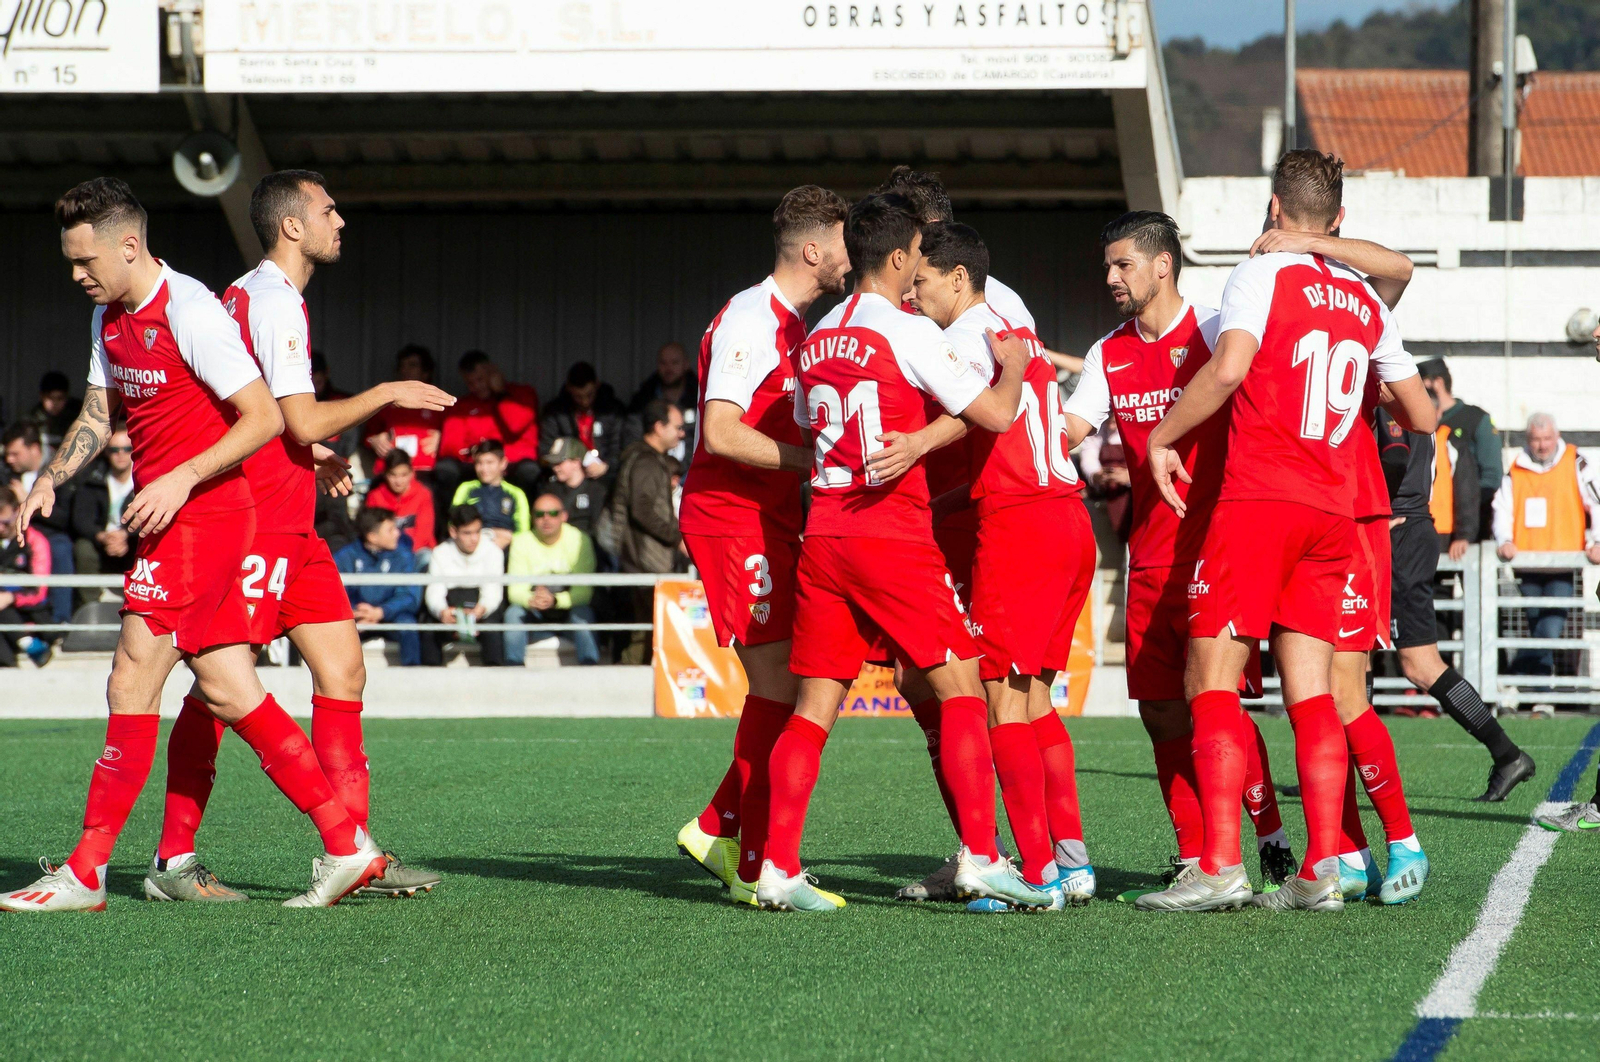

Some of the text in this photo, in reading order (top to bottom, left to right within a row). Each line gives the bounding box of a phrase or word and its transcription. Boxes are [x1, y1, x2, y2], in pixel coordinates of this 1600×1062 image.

[803, 4, 904, 28] OBRAS
[923, 5, 934, 27] Y
[53, 65, 78, 85] 15
[238, 57, 276, 67] Barrio
[283, 57, 318, 67] Santa
[1302, 283, 1372, 327] DE JONG
[800, 335, 876, 373] OLIVER.T
[123, 382, 141, 398] BET
[1113, 386, 1185, 409] ARATHO
[1291, 329, 1370, 449] 19
[1135, 405, 1166, 423] BET
[808, 380, 885, 489] 21
[1012, 380, 1079, 487] 16
[241, 554, 288, 601] 24
[744, 554, 773, 597] 3
